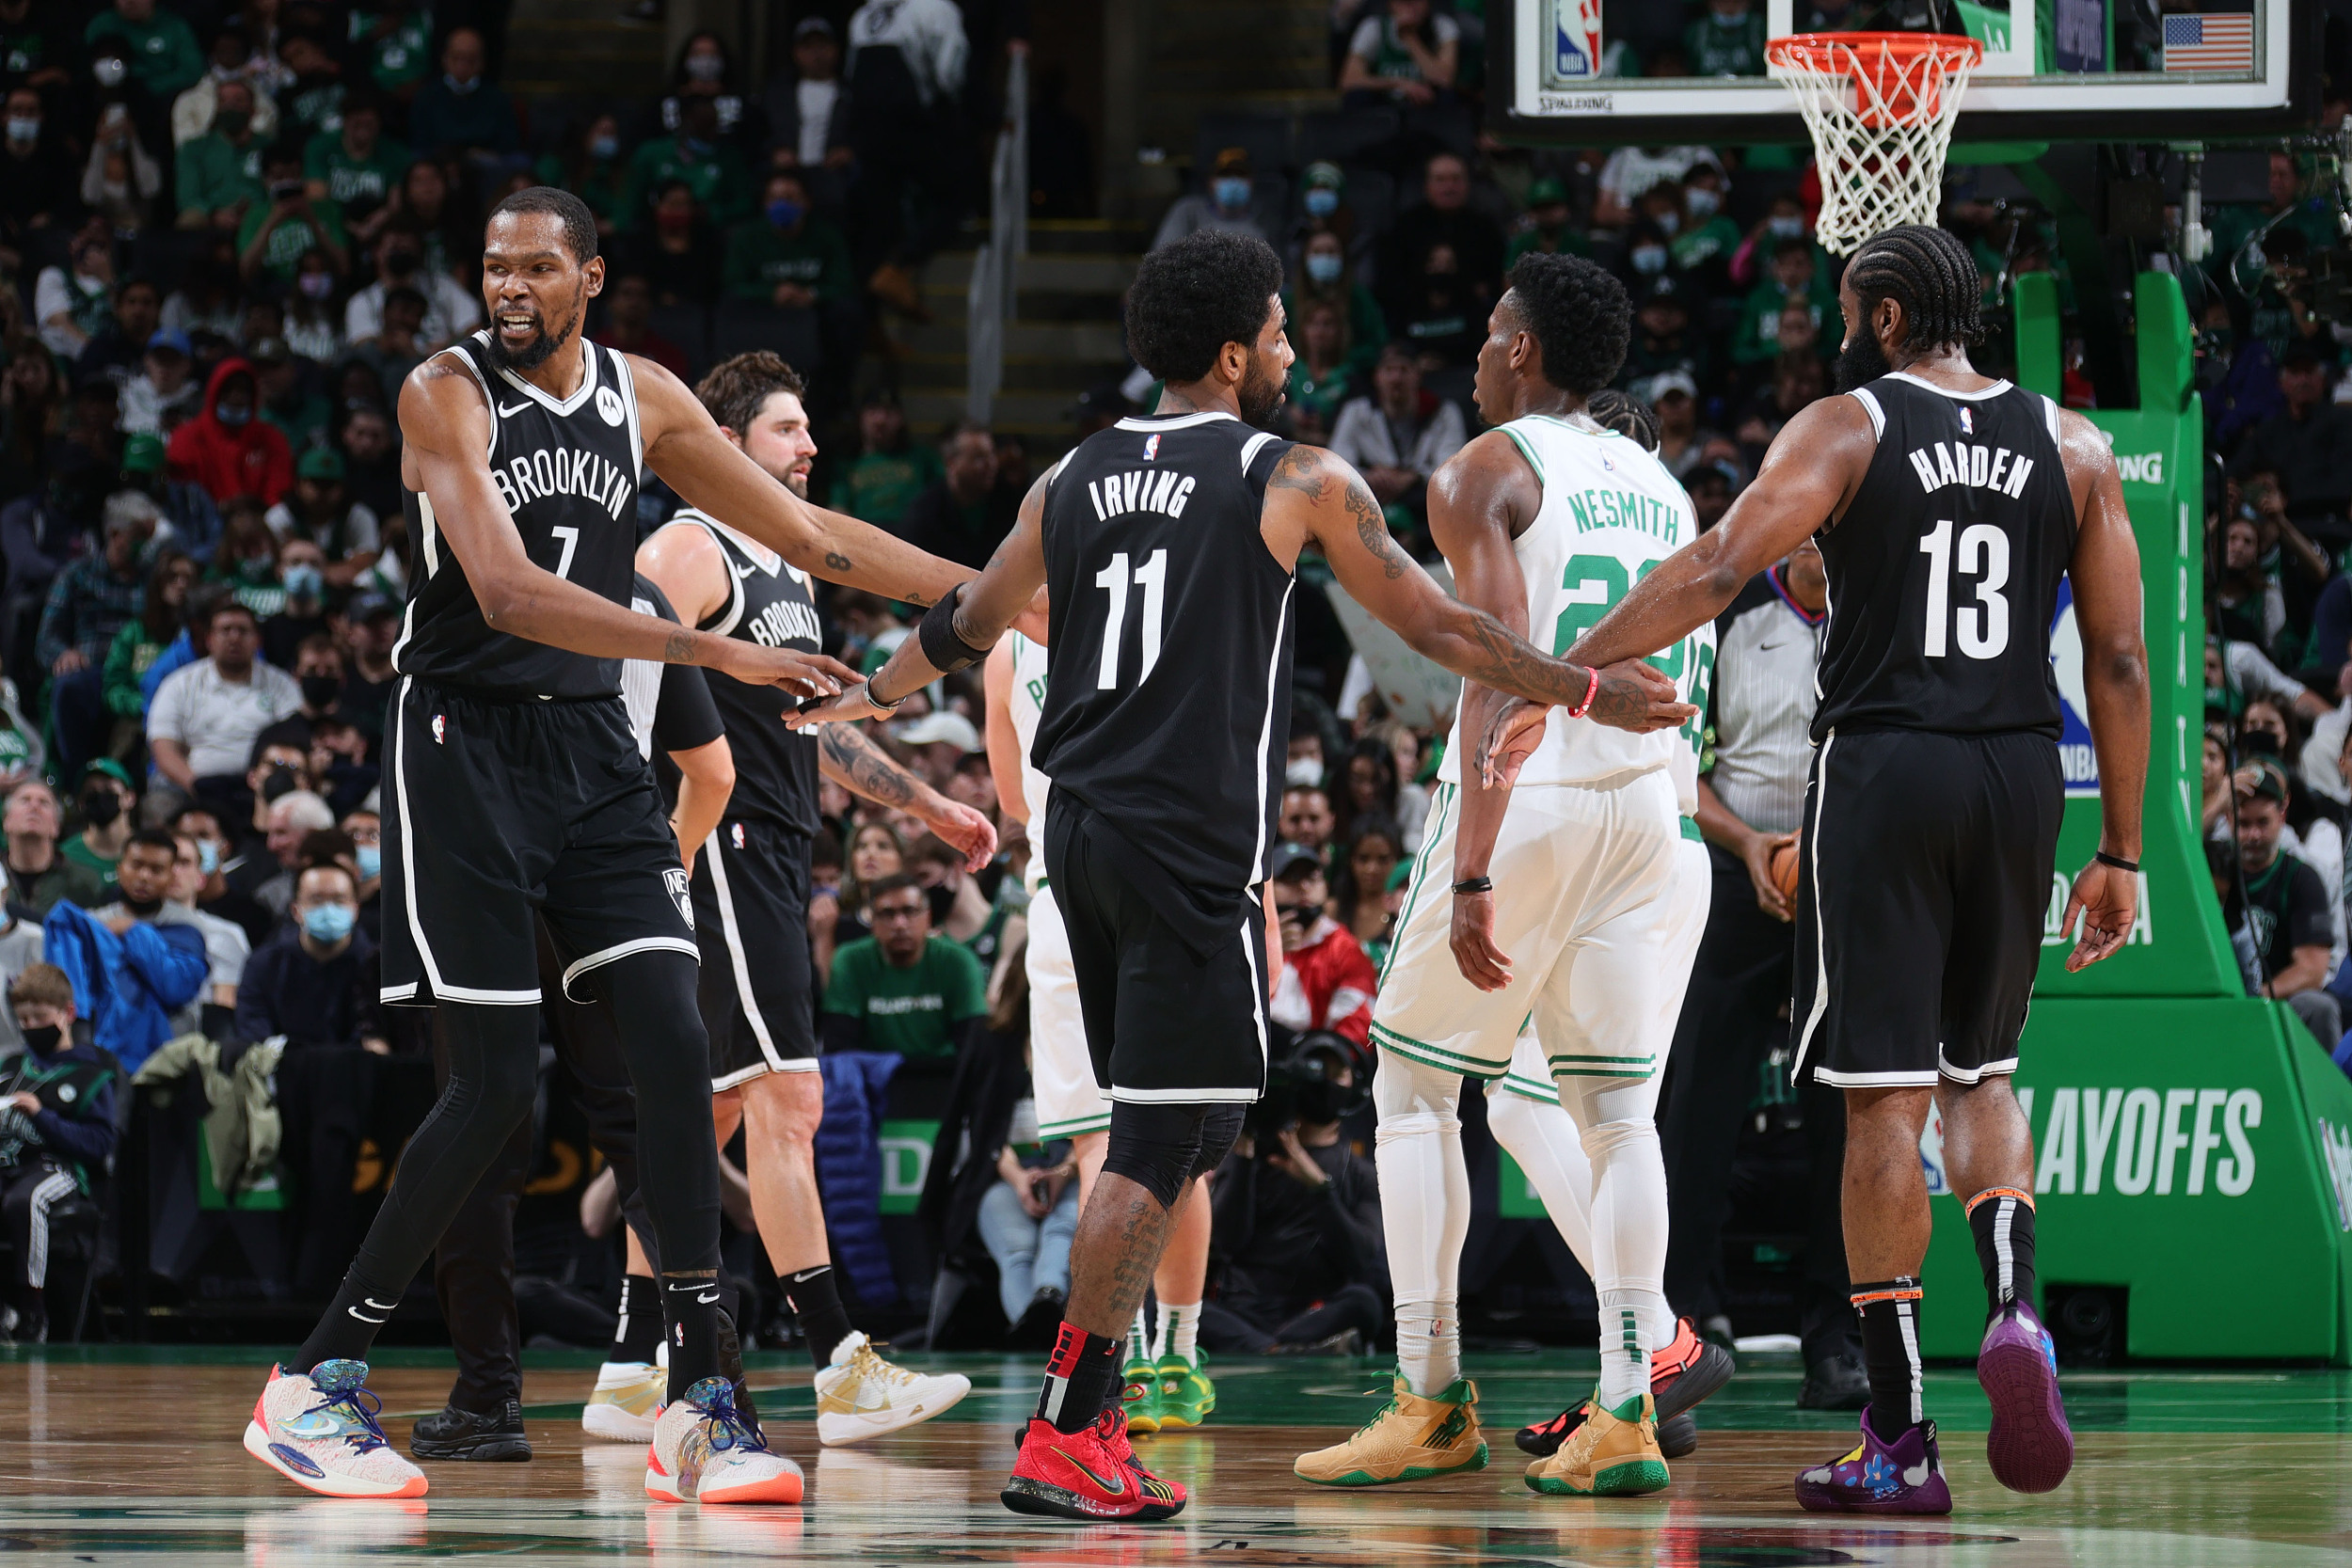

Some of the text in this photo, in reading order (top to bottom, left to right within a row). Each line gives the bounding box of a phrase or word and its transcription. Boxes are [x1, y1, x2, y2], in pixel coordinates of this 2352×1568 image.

[1560, 52, 1585, 72] NBA
[1539, 95, 1613, 113] SPALDING
[492, 447, 632, 522] BROOKLYN
[1088, 469, 1197, 522] IRVING
[1908, 440, 2035, 500] HARDEN
[1566, 488, 1679, 547] NESMITH
[551, 526, 580, 580] 7
[1095, 548, 1168, 690] 11
[1919, 519, 2010, 660] 13
